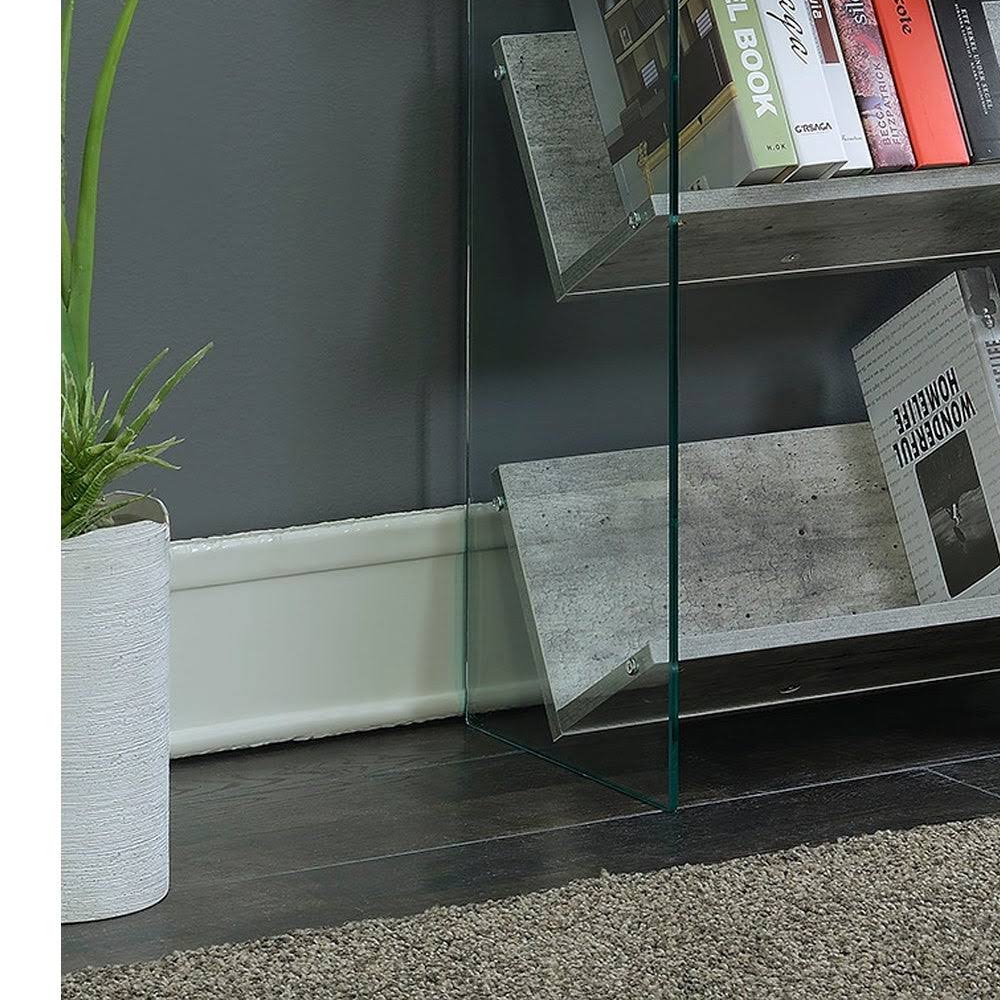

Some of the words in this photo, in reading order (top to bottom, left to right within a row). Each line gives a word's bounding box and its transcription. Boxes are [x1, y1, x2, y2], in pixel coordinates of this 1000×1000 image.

[733, 27, 779, 118] BOOK
[872, 61, 901, 146] FITZPATRICK
[876, 103, 891, 146] BECCA
[892, 367, 960, 436] HOMELIFE
[892, 390, 977, 469] WONDERFUL
